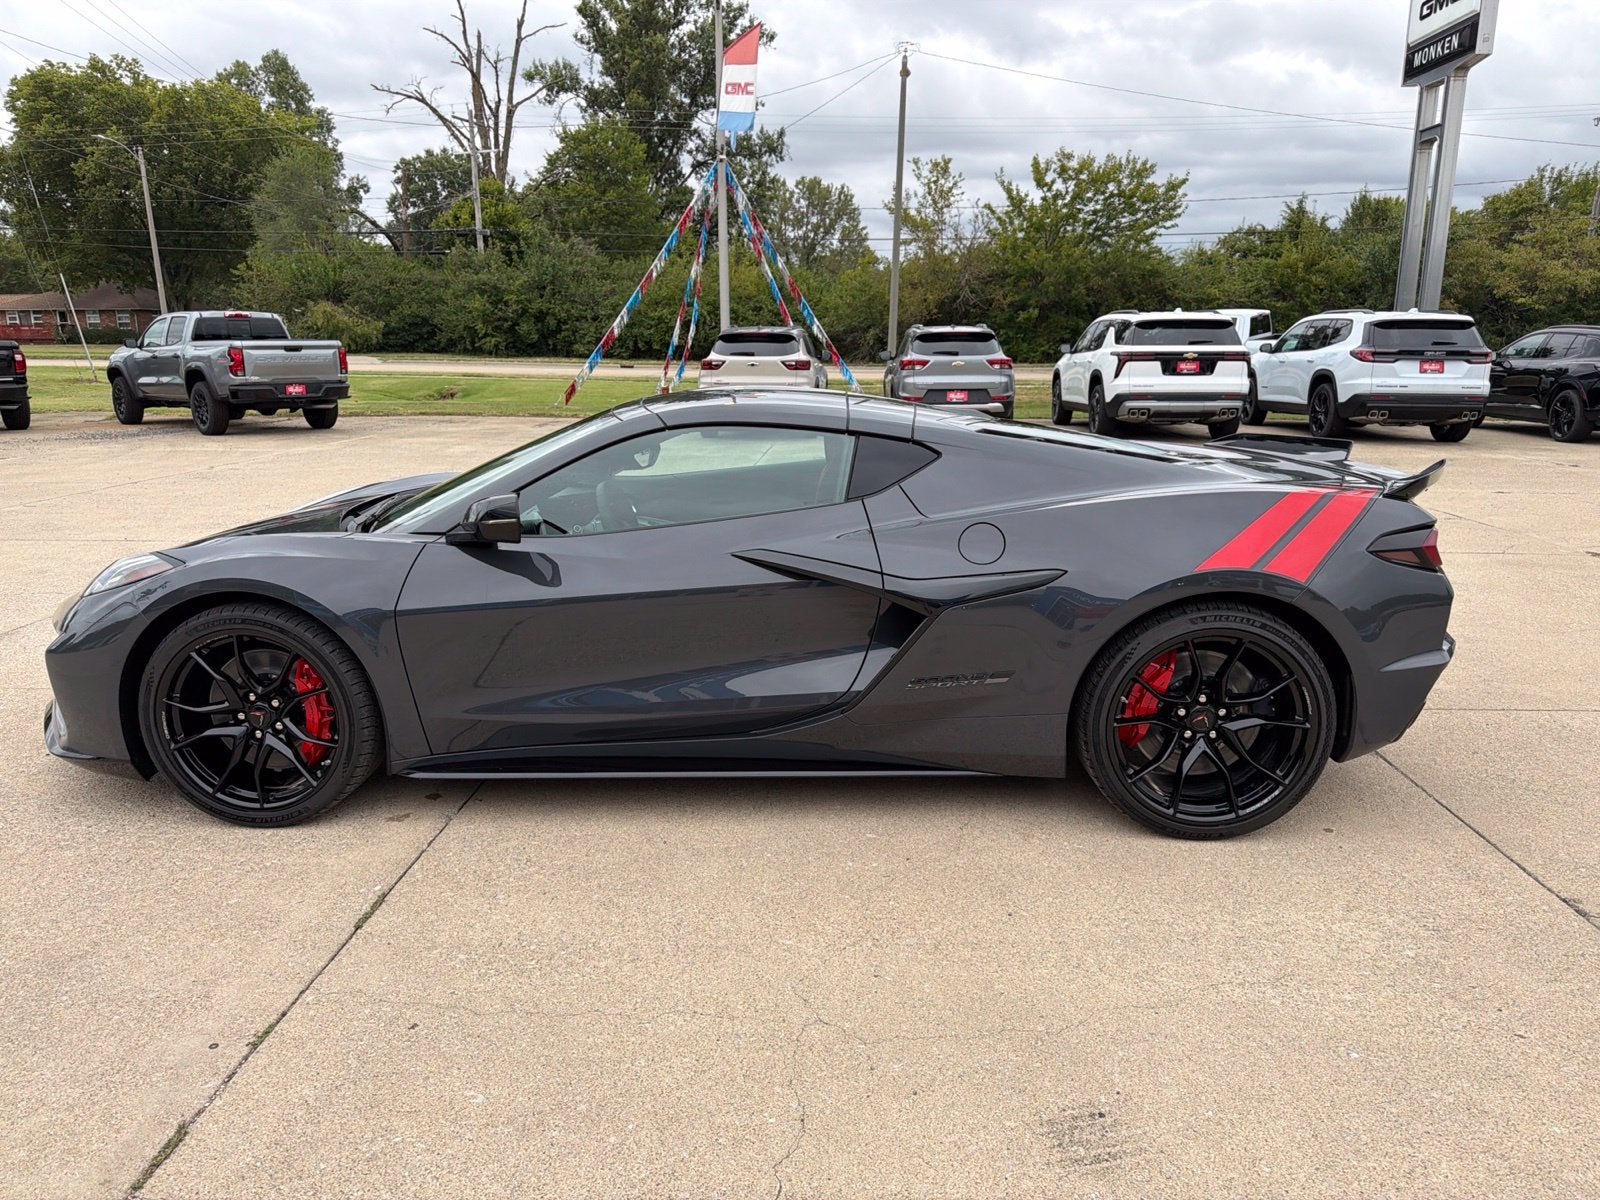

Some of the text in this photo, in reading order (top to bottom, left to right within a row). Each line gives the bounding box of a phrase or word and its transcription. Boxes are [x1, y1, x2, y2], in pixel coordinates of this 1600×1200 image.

[1419, 0, 1461, 21] GM
[1413, 33, 1459, 68] MONKEN
[724, 82, 755, 96] GMC
[1205, 615, 1262, 628] MICHELIN
